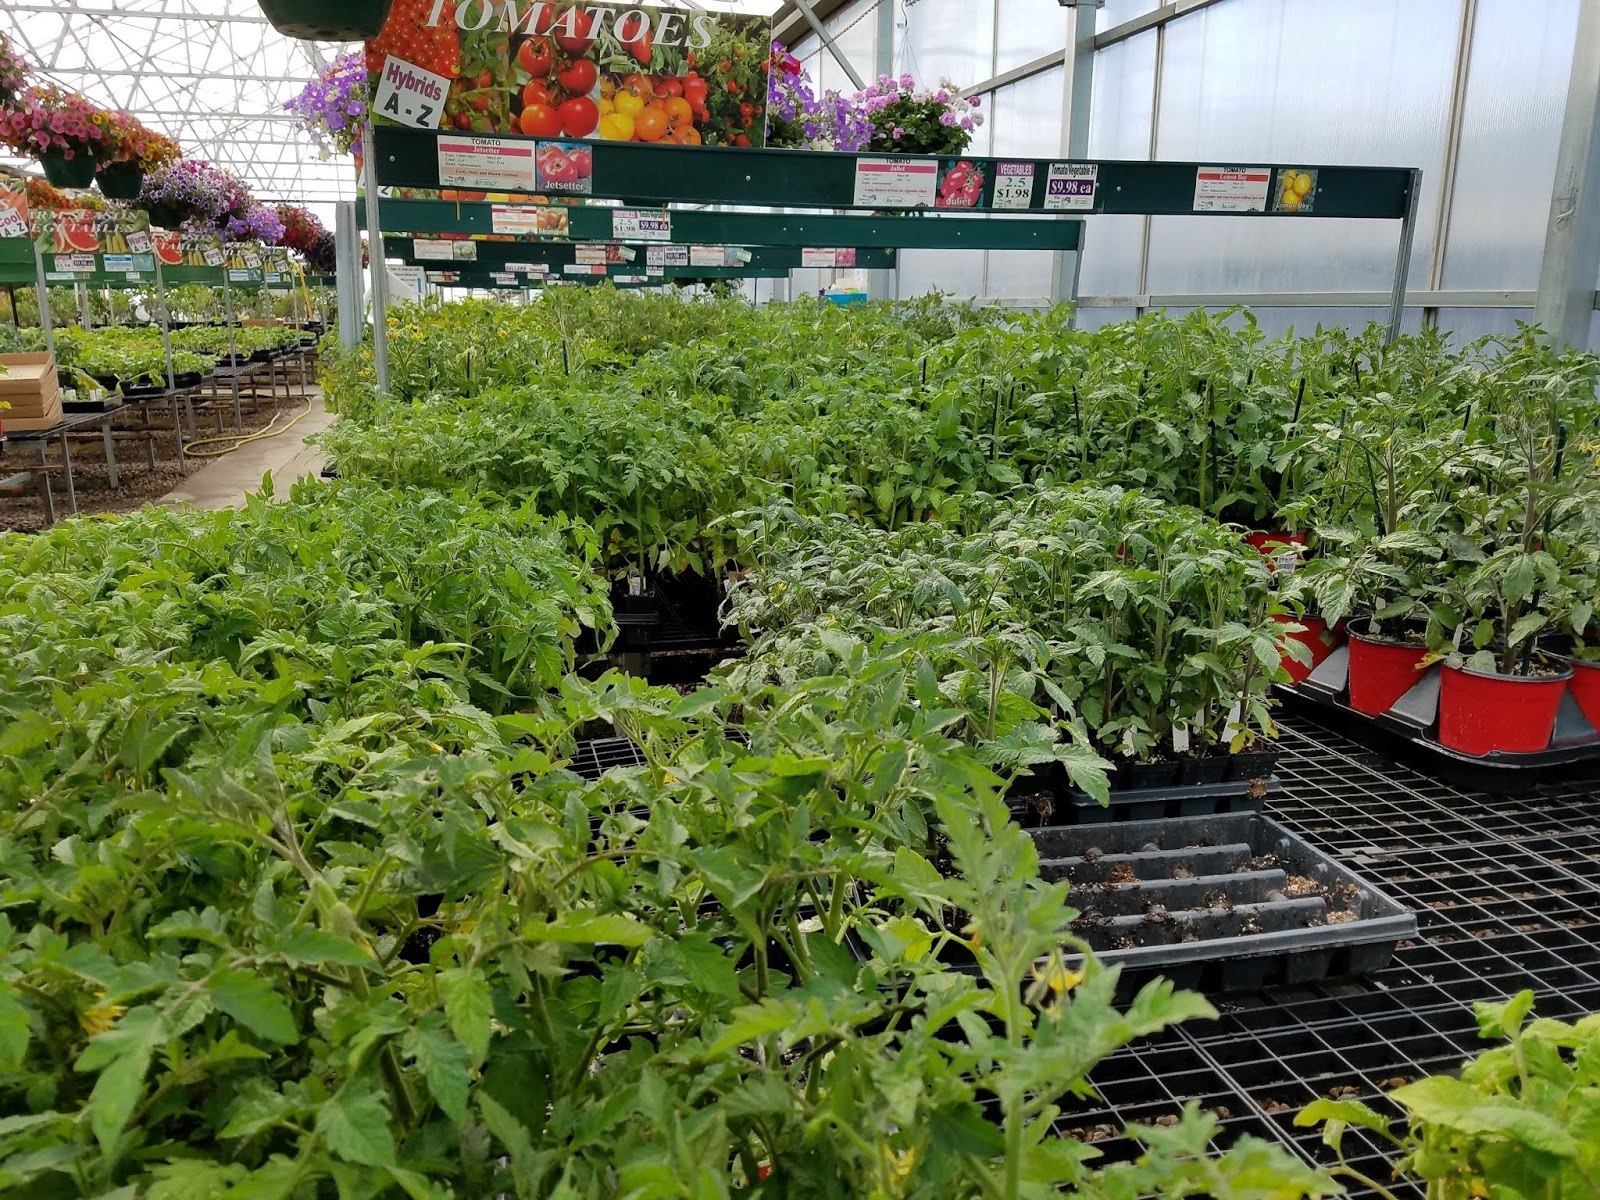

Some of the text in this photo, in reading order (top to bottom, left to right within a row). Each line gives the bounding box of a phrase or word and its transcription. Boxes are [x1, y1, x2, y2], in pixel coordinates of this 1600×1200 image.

[424, 0, 719, 49] TOMATOES
[386, 62, 442, 101] Hybrids
[383, 92, 399, 116] A
[416, 104, 434, 128] Z
[471, 138, 501, 147] TOMATO
[472, 146, 501, 154] Jetsetter
[1000, 164, 1032, 175] VEGETABLES
[545, 181, 584, 190] Jetsetter
[1005, 177, 1026, 187] 2.5
[1051, 181, 1092, 193] $9.98 ea
[996, 188, 1030, 199] $1.98
[945, 196, 971, 205] Juliet
[1297, 202, 1310, 210] Boy
[17, 222, 25, 232] Z
[640, 221, 659, 230] $9.98
[128, 235, 148, 245] Warm
